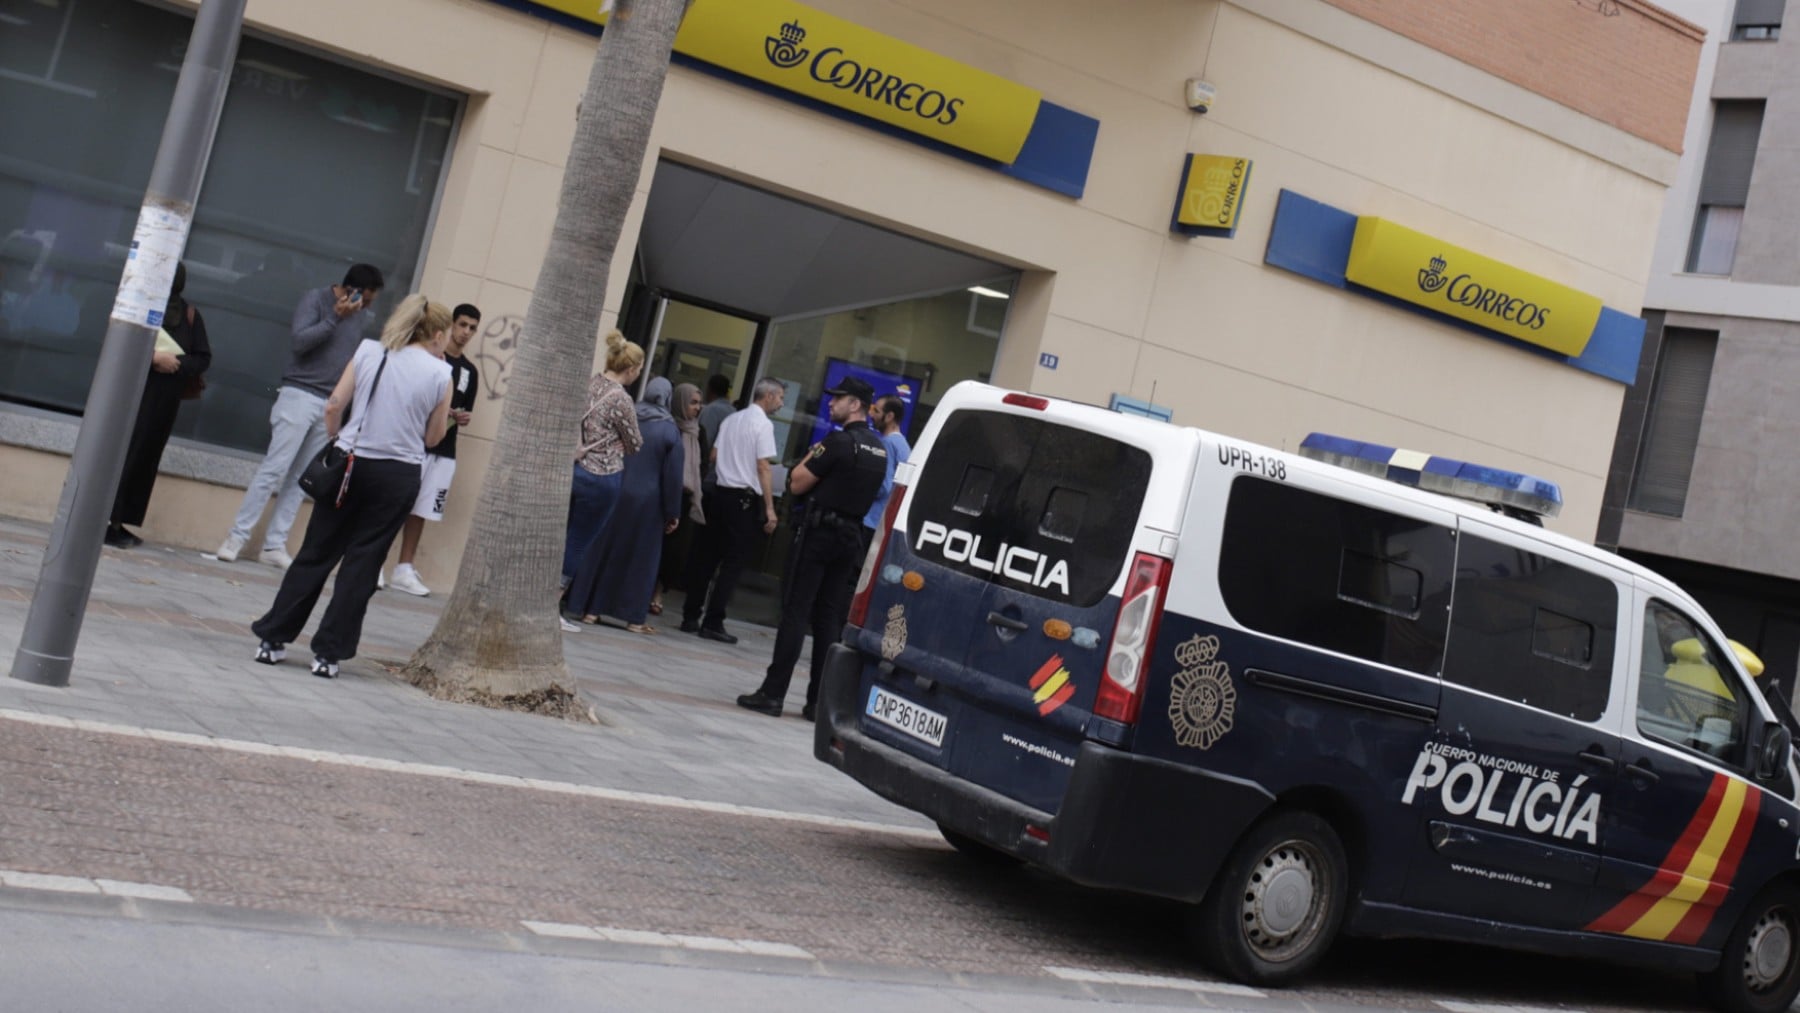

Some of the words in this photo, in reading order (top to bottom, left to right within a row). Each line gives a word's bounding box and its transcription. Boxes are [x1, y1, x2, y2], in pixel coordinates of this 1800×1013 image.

[809, 47, 964, 125] CORREOS
[1217, 158, 1244, 224] CORREOS
[1446, 274, 1551, 330] CORREOS
[1042, 354, 1056, 367] 19
[1218, 443, 1286, 480] UPR-138
[915, 520, 1069, 595] POLICIA
[1002, 733, 1076, 767] www.policia.es
[1423, 741, 1477, 764] CUERPO
[1478, 754, 1540, 778] NACIONAL
[1542, 769, 1561, 783] DE
[1401, 751, 1602, 845] POLICÍA
[1451, 863, 1552, 890] www.policia.es
